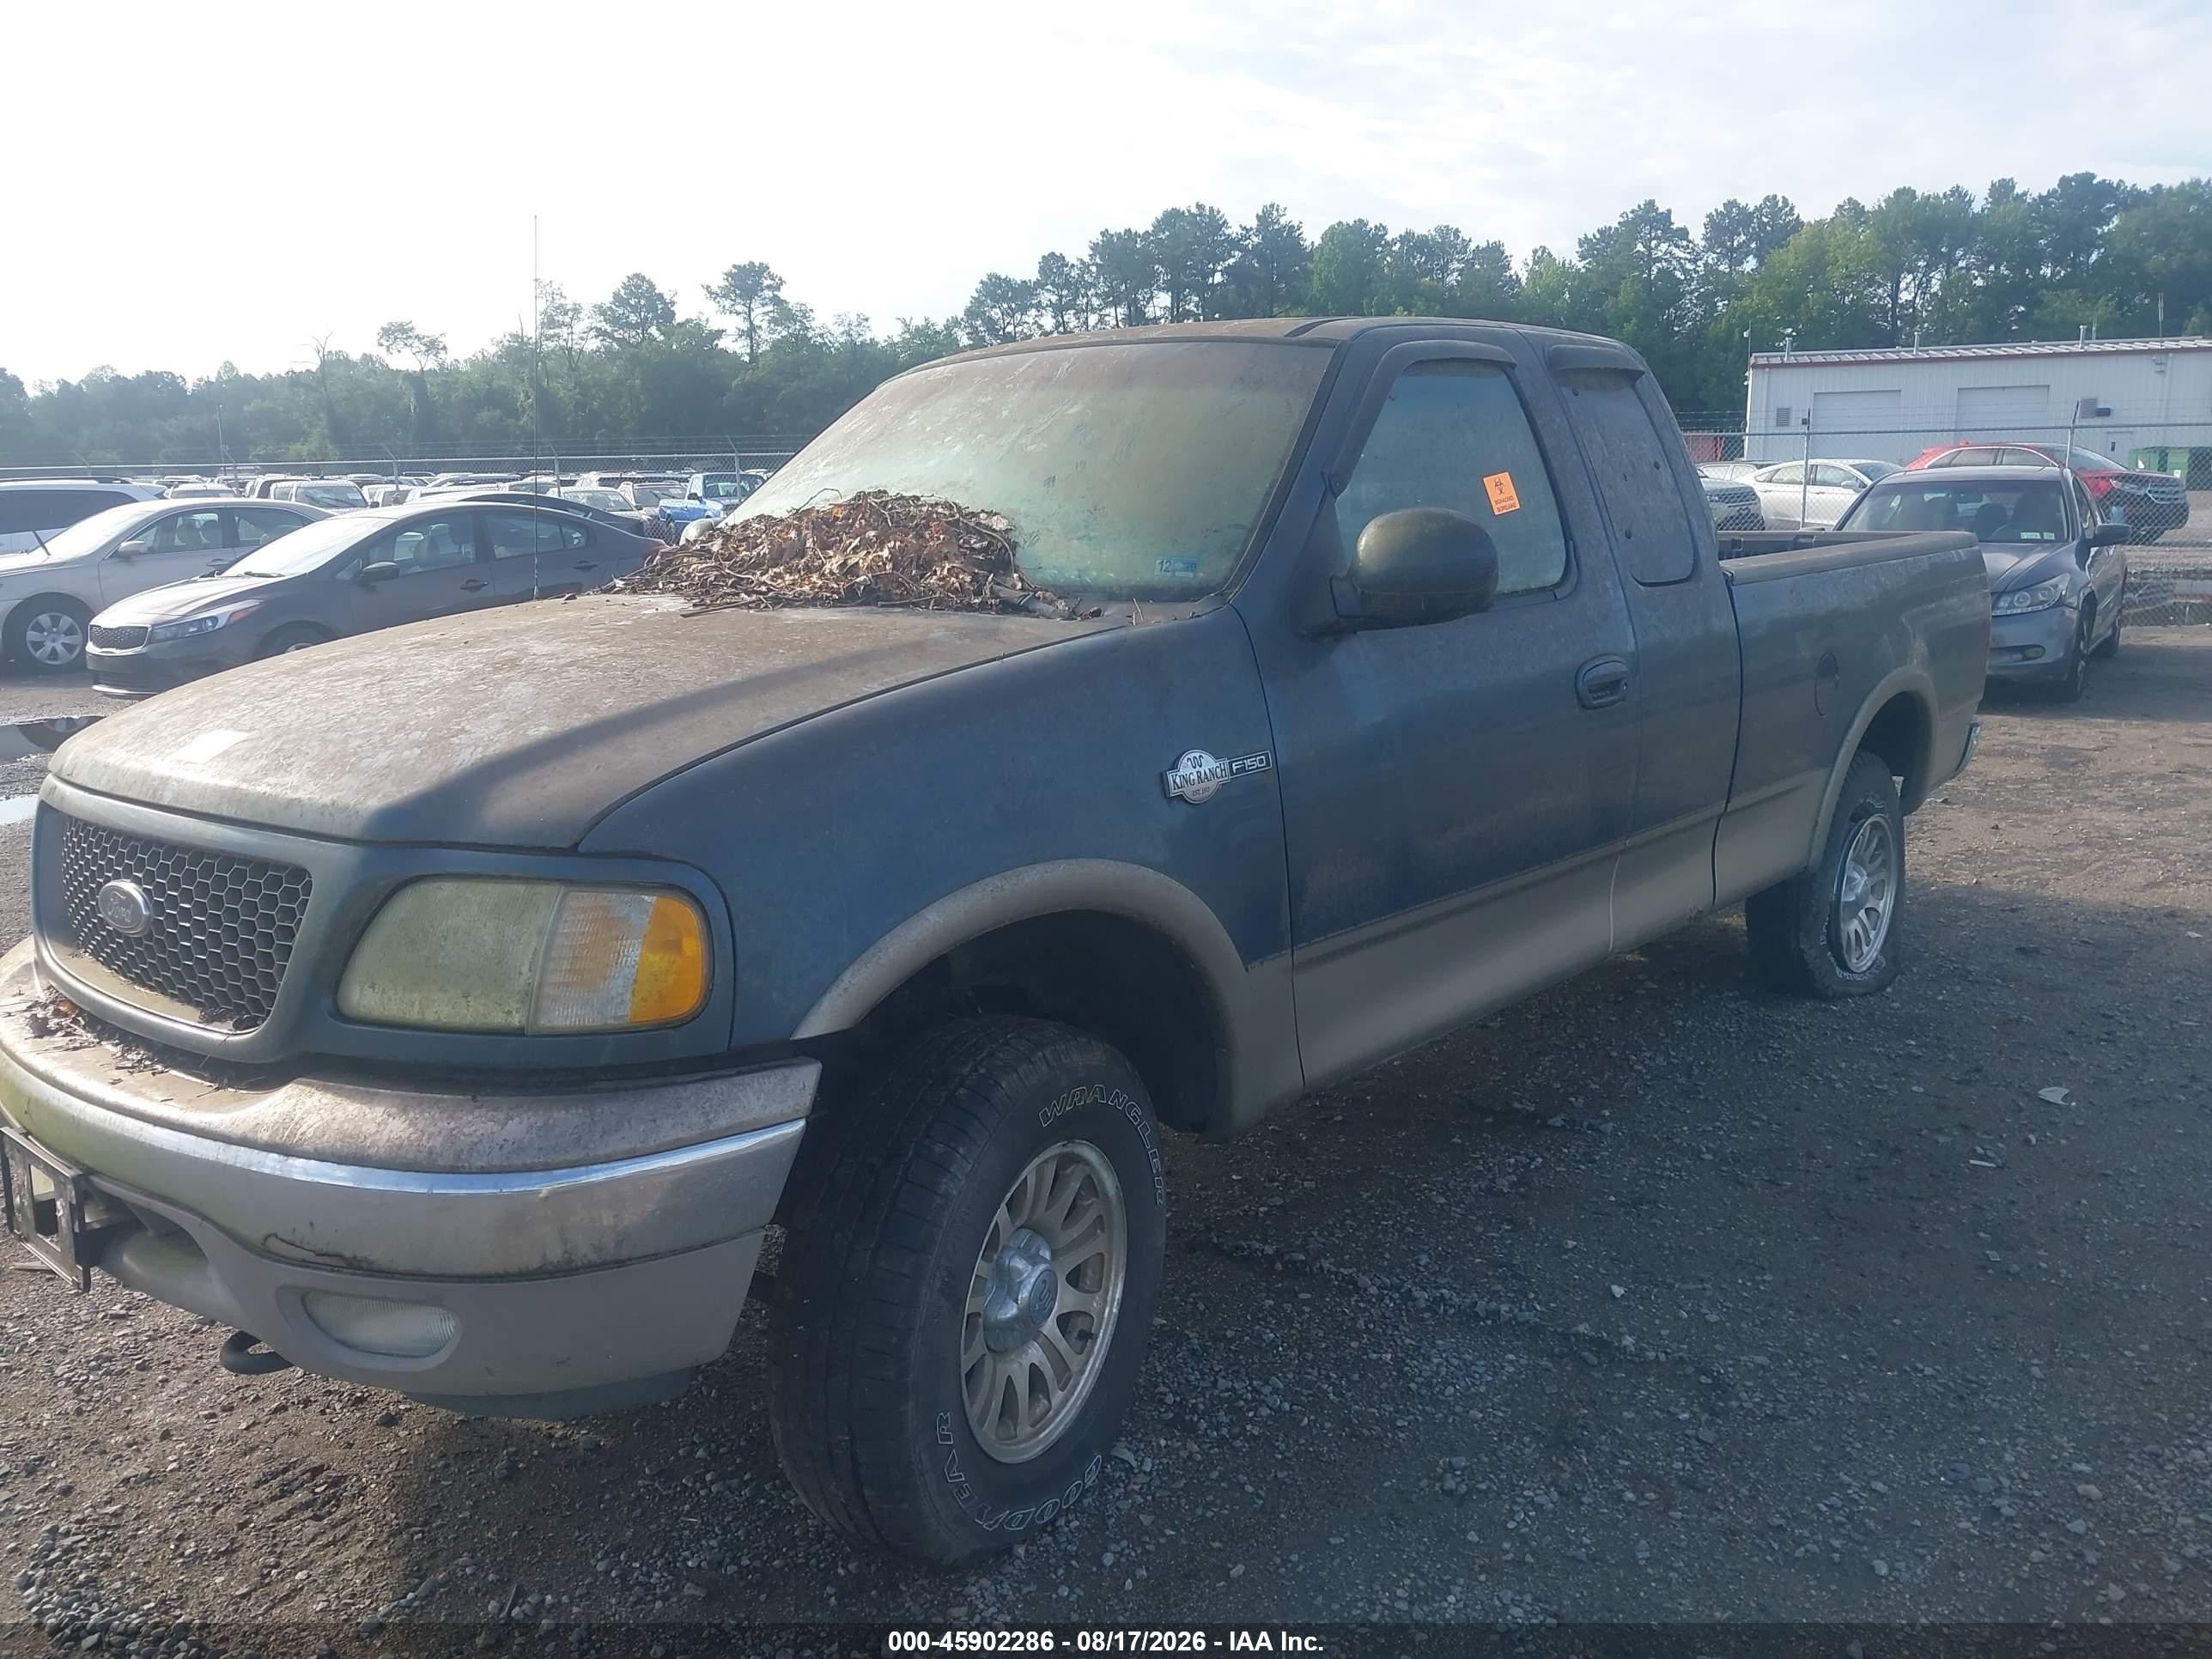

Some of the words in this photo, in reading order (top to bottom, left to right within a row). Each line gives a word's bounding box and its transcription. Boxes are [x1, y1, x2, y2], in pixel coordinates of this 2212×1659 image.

[1158, 560, 1172, 573] 12
[1170, 771, 1195, 791] KING
[1197, 762, 1227, 785] RANCH
[1038, 1084, 1164, 1206] WRANGLER
[937, 1412, 1103, 1532] GOODYEAR
